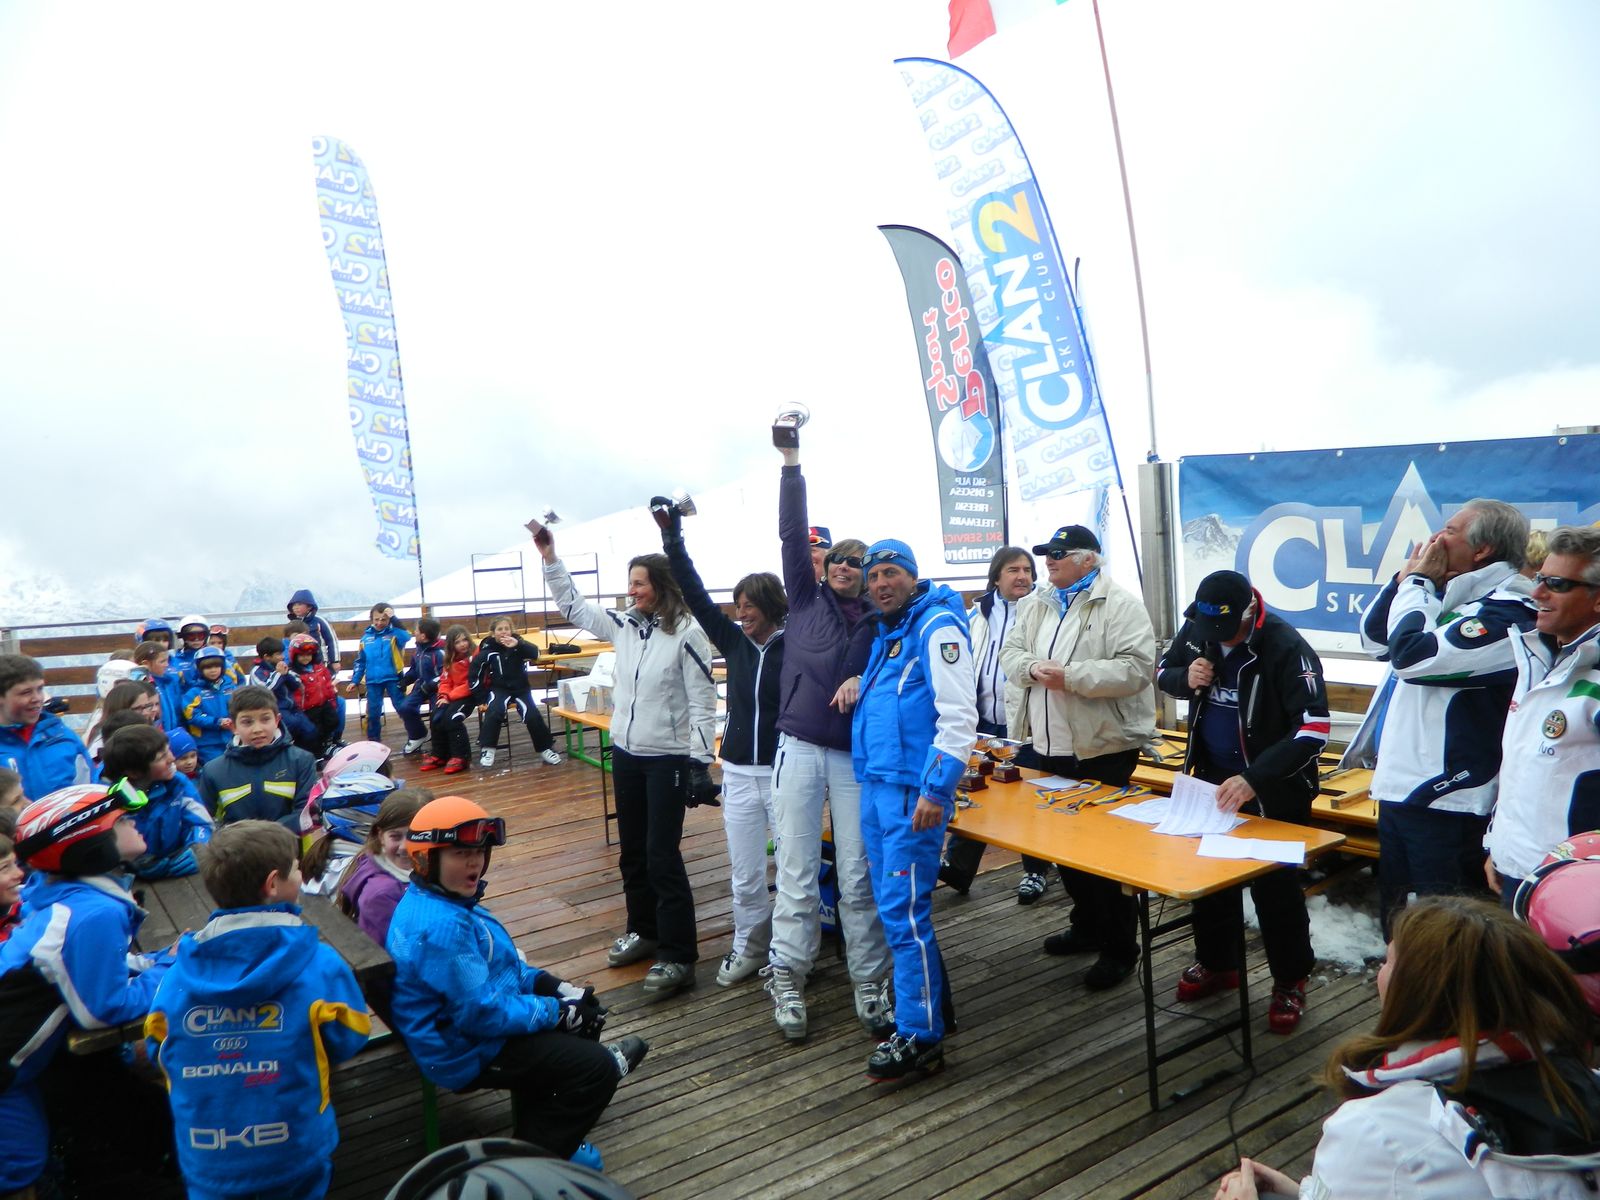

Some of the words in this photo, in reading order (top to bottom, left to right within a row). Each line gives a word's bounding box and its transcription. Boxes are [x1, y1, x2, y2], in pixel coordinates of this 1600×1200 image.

[1032, 251, 1055, 301] CLUB
[978, 190, 1083, 422] CLAN2
[1056, 336, 1075, 369] SKI
[52, 798, 115, 836] SCOTT
[187, 1003, 279, 1032] CLAN2
[182, 1060, 279, 1079] BONALDI
[189, 1121, 289, 1150] DKB
